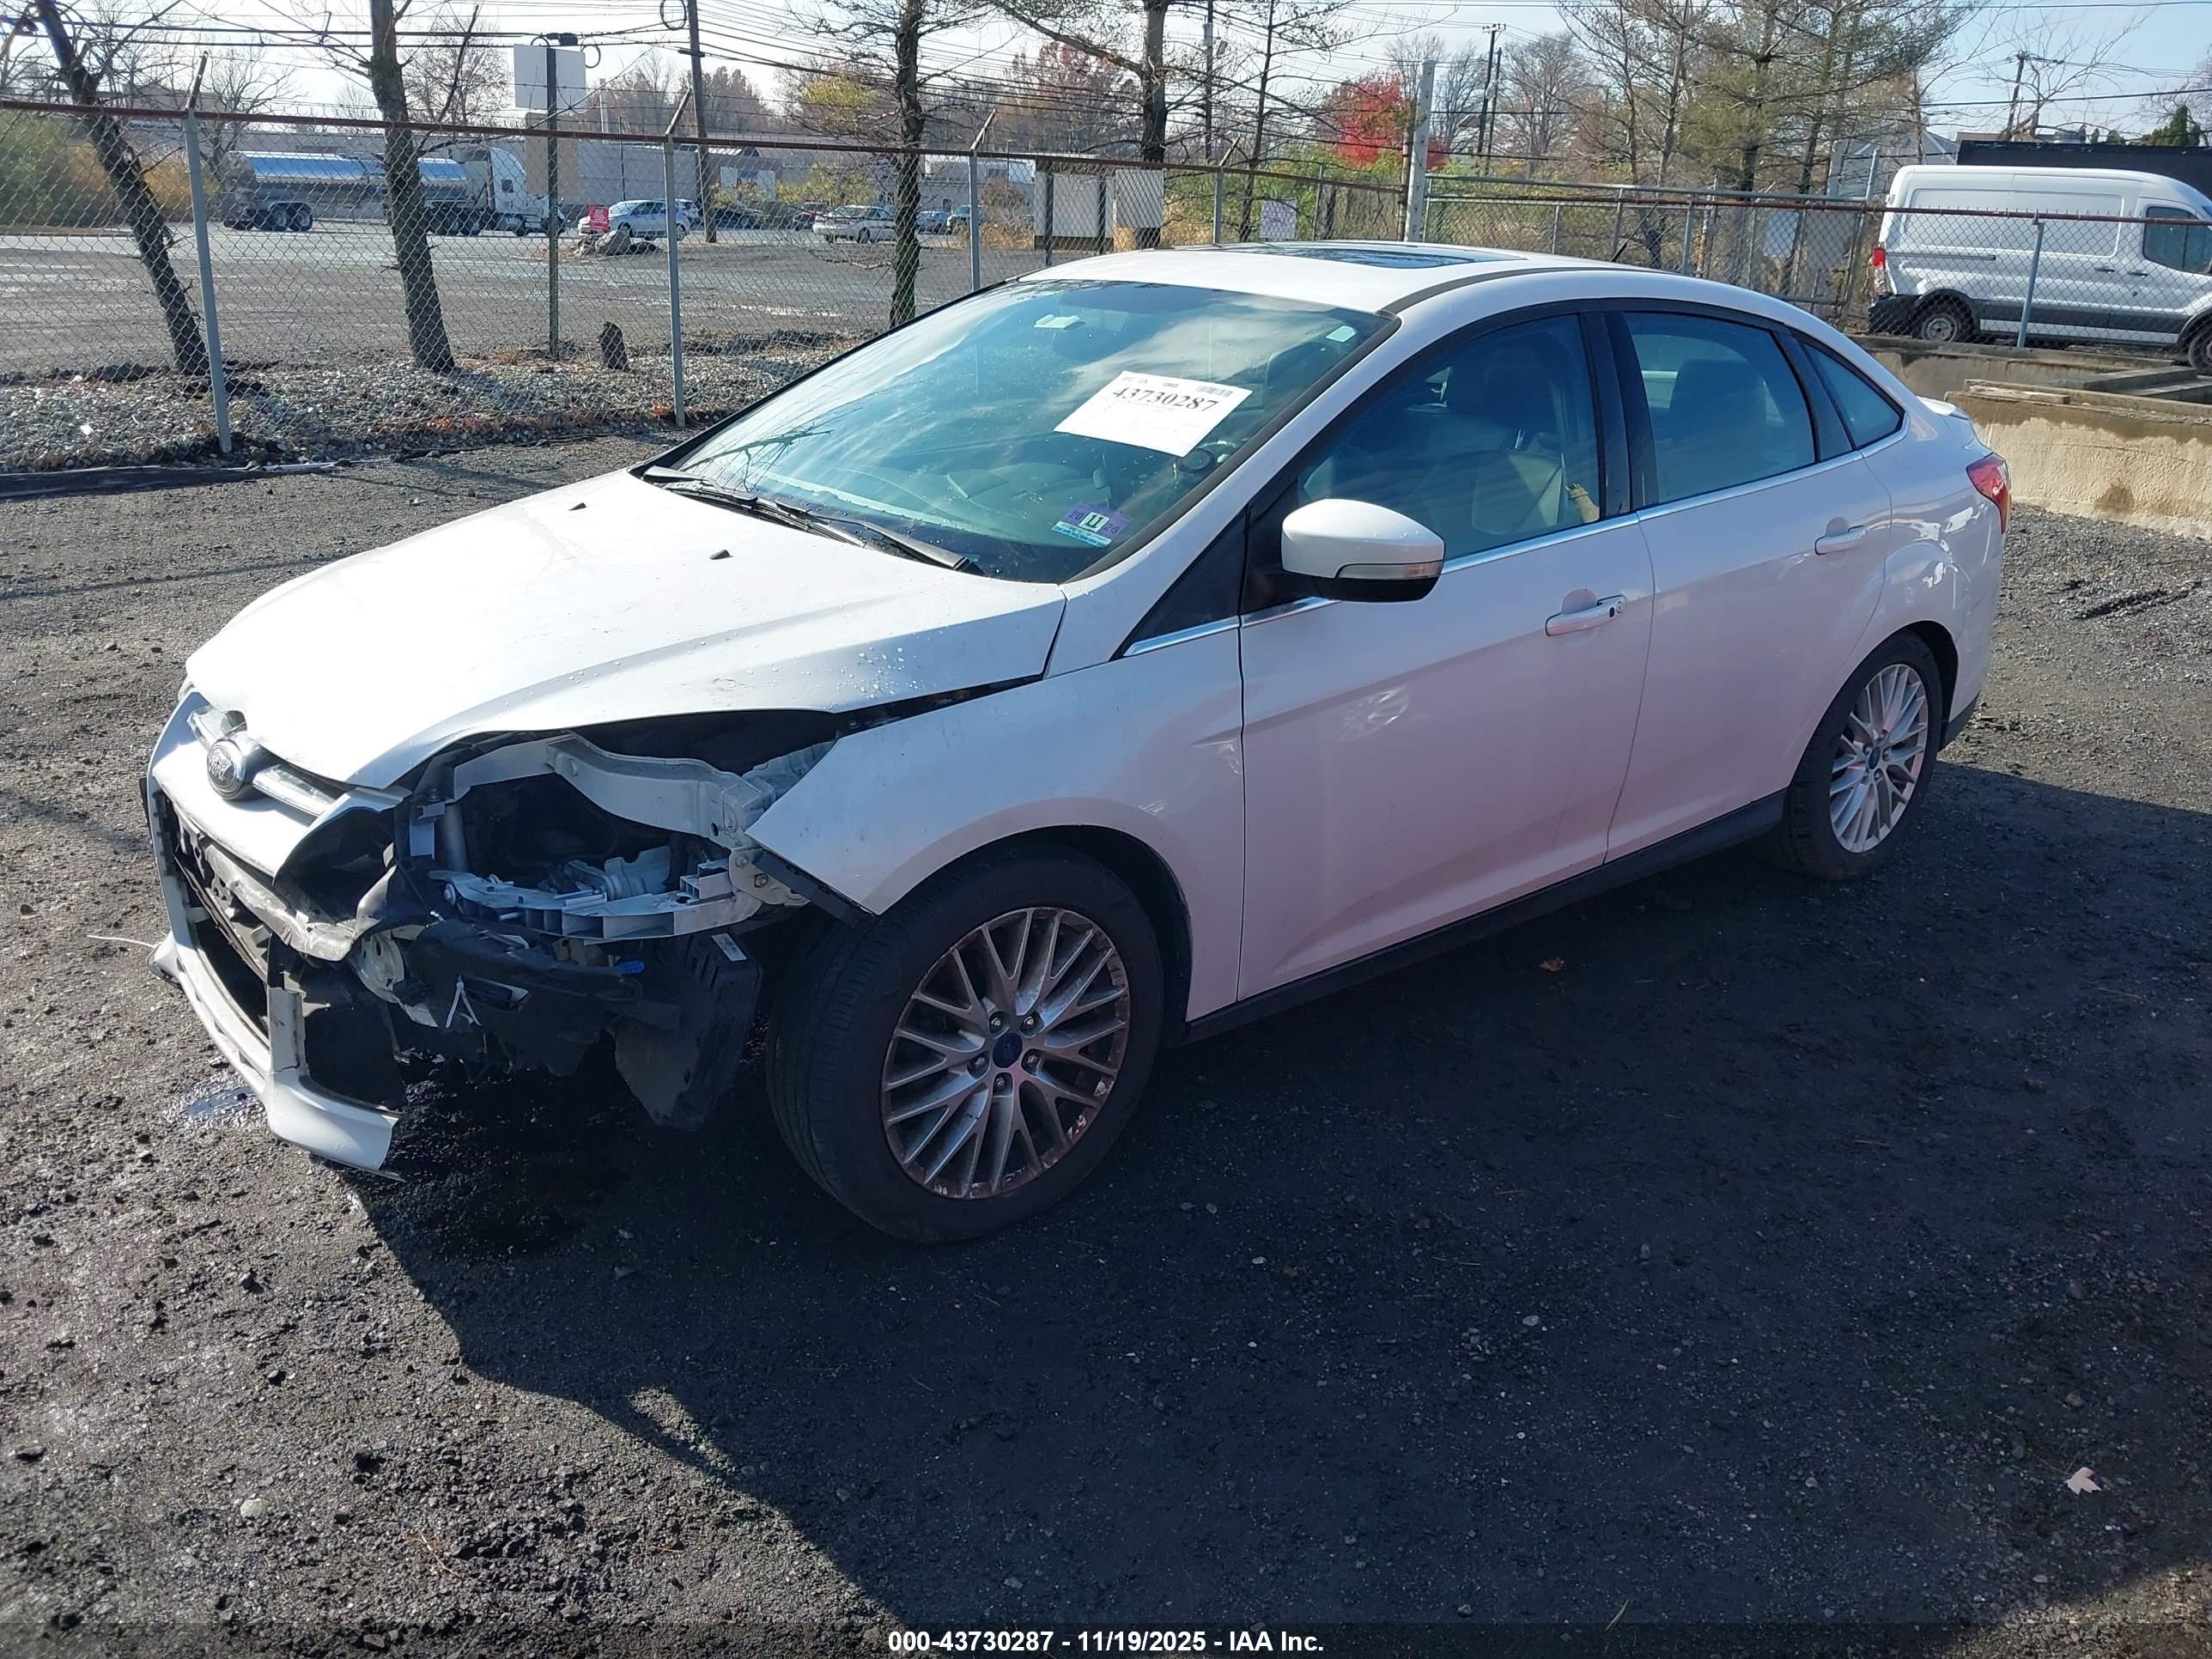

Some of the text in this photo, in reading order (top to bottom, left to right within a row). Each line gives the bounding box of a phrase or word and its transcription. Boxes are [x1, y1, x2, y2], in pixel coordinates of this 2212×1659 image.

[1113, 387, 1219, 412] 43730287
[1085, 515, 1103, 528] 11
[1103, 523, 1121, 534] 26
